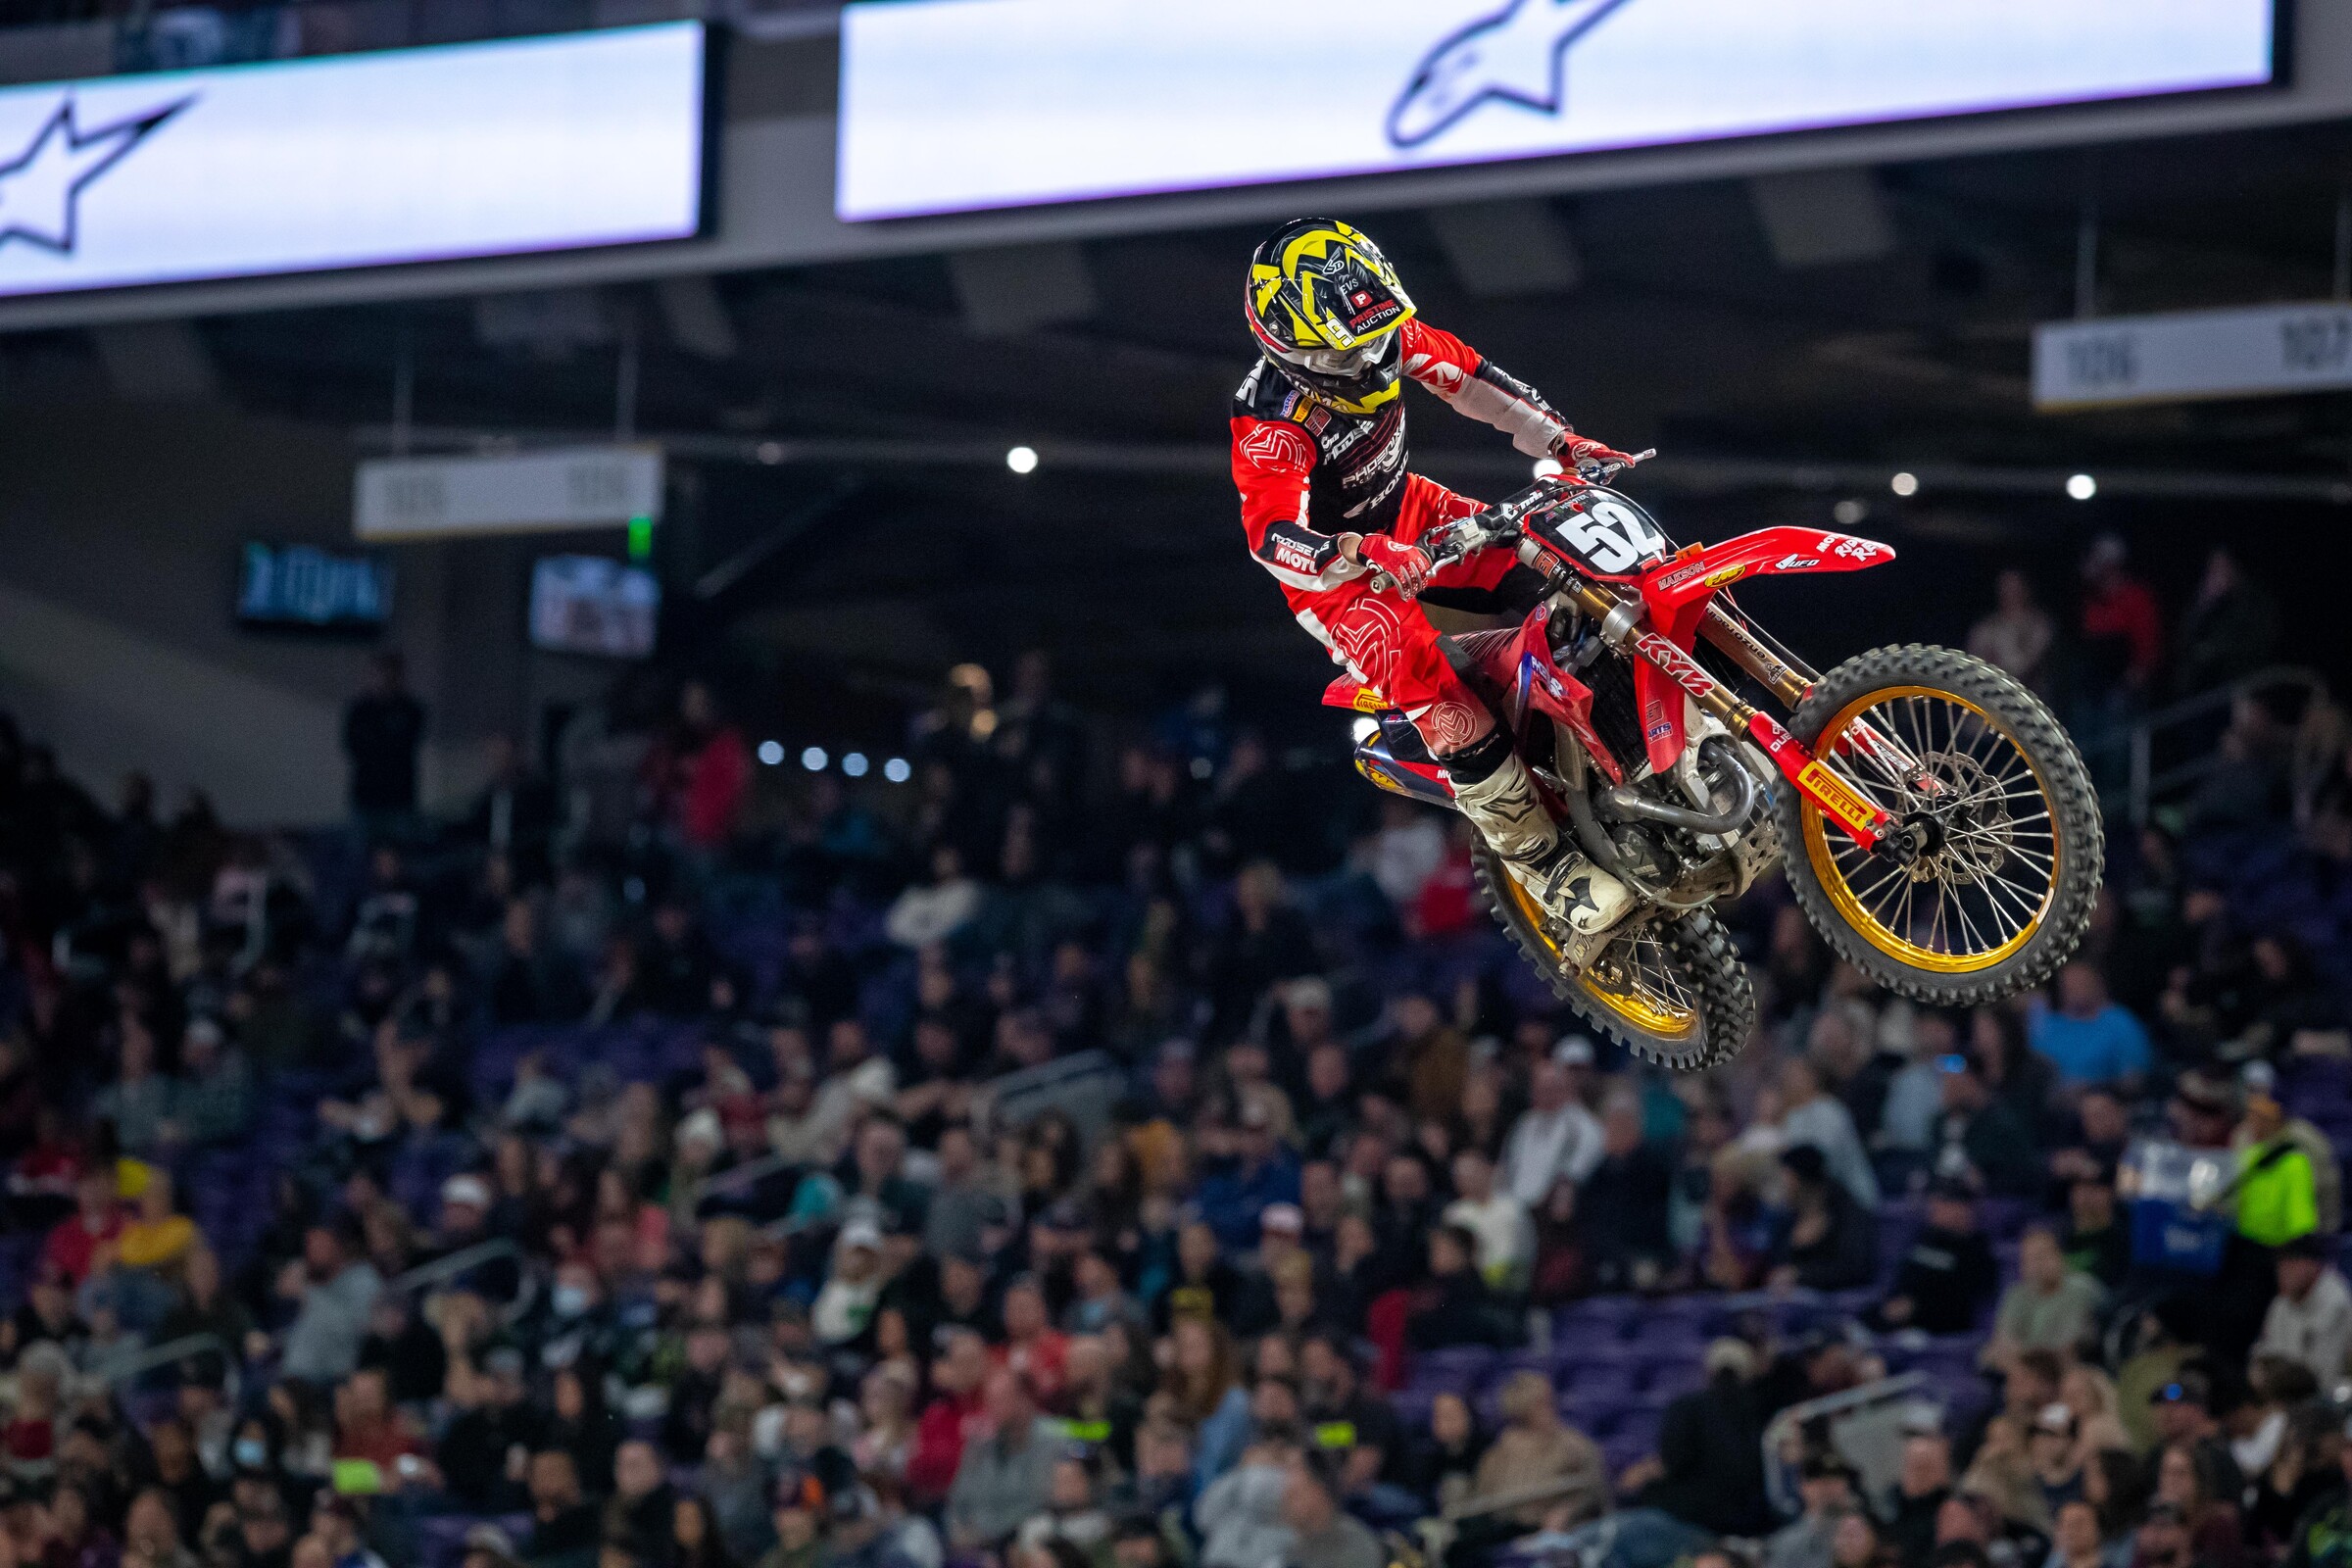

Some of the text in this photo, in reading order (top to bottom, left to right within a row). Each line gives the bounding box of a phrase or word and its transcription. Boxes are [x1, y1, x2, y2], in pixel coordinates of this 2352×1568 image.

[1340, 277, 1359, 295] EVS
[1348, 299, 1396, 329] PRISTINE
[1356, 305, 1400, 333] AUCTION
[1370, 449, 1409, 510] HOND
[1555, 501, 1665, 573] 52
[1276, 547, 1318, 574] MOTU
[1658, 561, 1706, 590] MAKSON
[1706, 566, 1744, 587] FMF
[1636, 632, 1715, 698] KYB
[1806, 768, 1868, 823] PIRELLI
